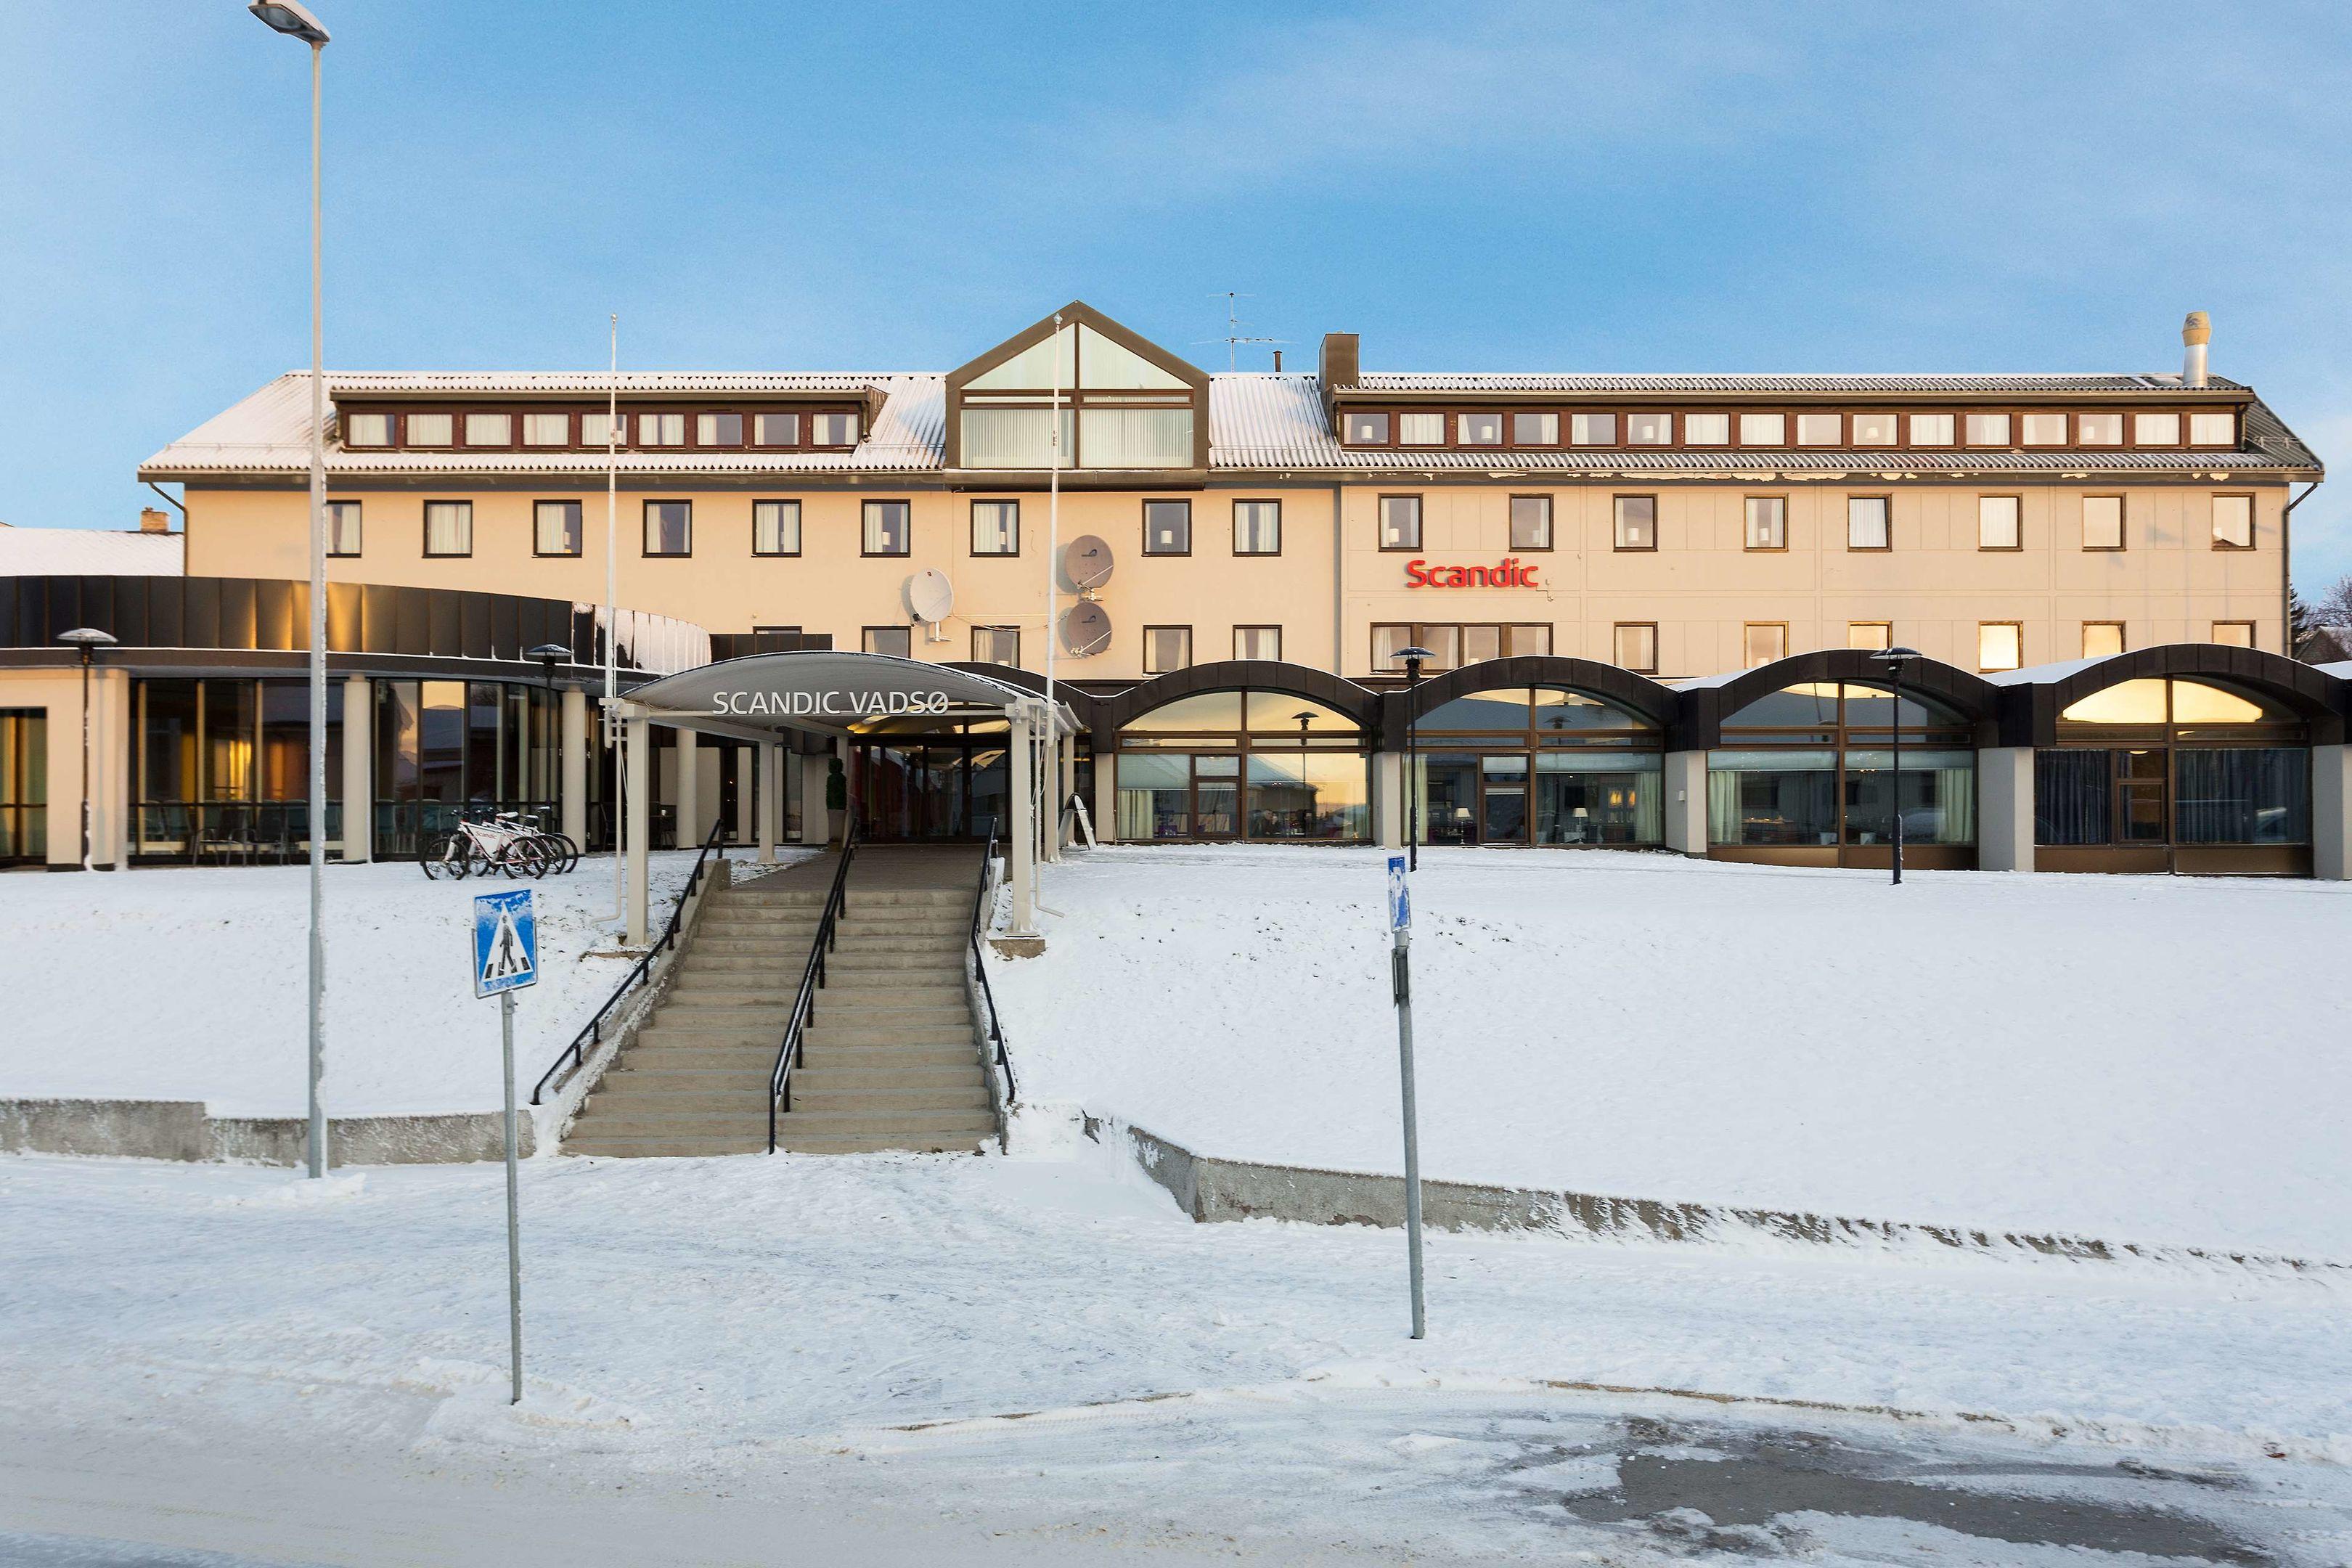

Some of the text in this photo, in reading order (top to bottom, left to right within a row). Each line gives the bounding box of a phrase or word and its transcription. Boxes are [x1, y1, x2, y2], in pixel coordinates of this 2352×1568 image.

[1406, 558, 1539, 588] Scandic
[712, 690, 950, 715] SCANDIC VADSØ
